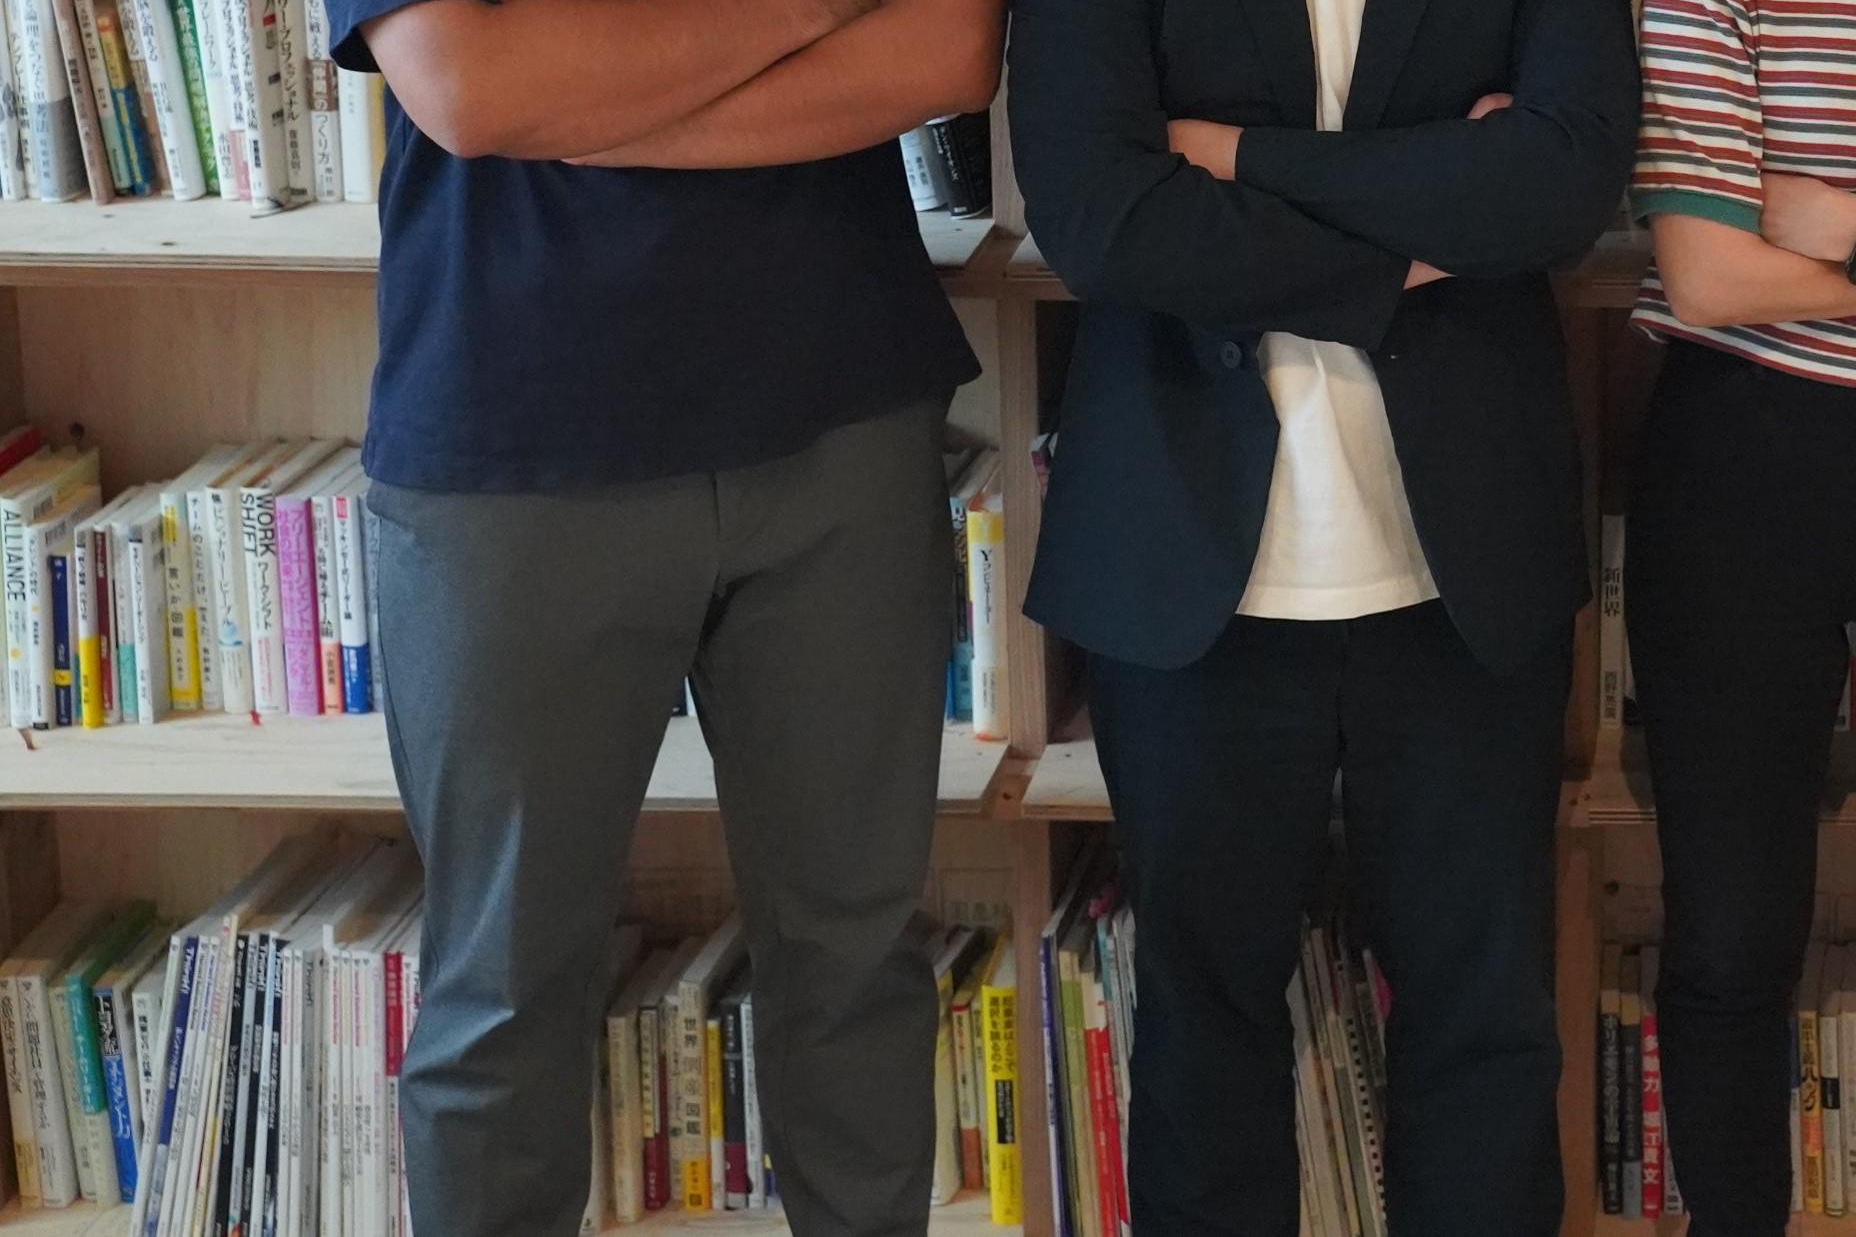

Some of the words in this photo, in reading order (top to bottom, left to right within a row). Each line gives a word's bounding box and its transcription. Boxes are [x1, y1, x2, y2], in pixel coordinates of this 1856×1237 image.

[3, 509, 26, 603] ALLIANCE
[240, 493, 259, 557] SHIFT
[257, 493, 277, 557] WORK
